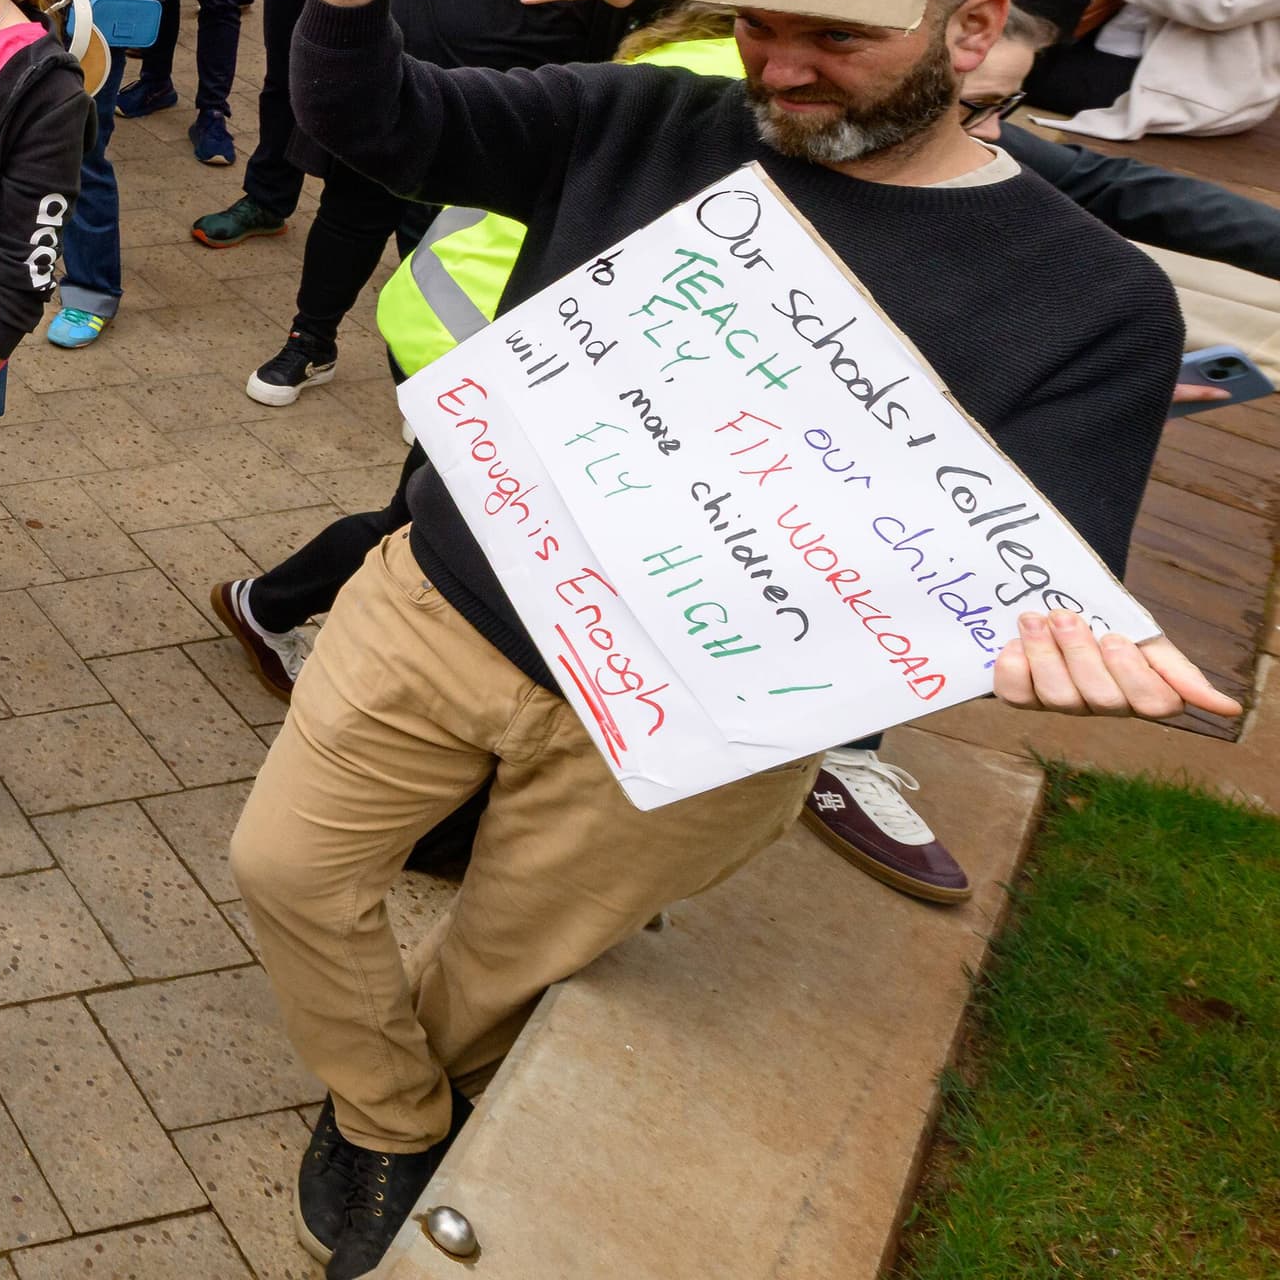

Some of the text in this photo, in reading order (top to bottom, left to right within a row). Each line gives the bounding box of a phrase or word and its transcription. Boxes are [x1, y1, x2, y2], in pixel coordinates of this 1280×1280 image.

[661, 248, 871, 490] TEACH our
[696, 190, 775, 272] Our
[436, 377, 671, 738] Enough is Enough
[505, 329, 570, 389] will
[564, 421, 653, 500] FLY
[558, 296, 811, 643] and more children
[585, 248, 626, 287] to
[714, 410, 794, 488] FIX
[776, 504, 947, 701] WORKLOAD
